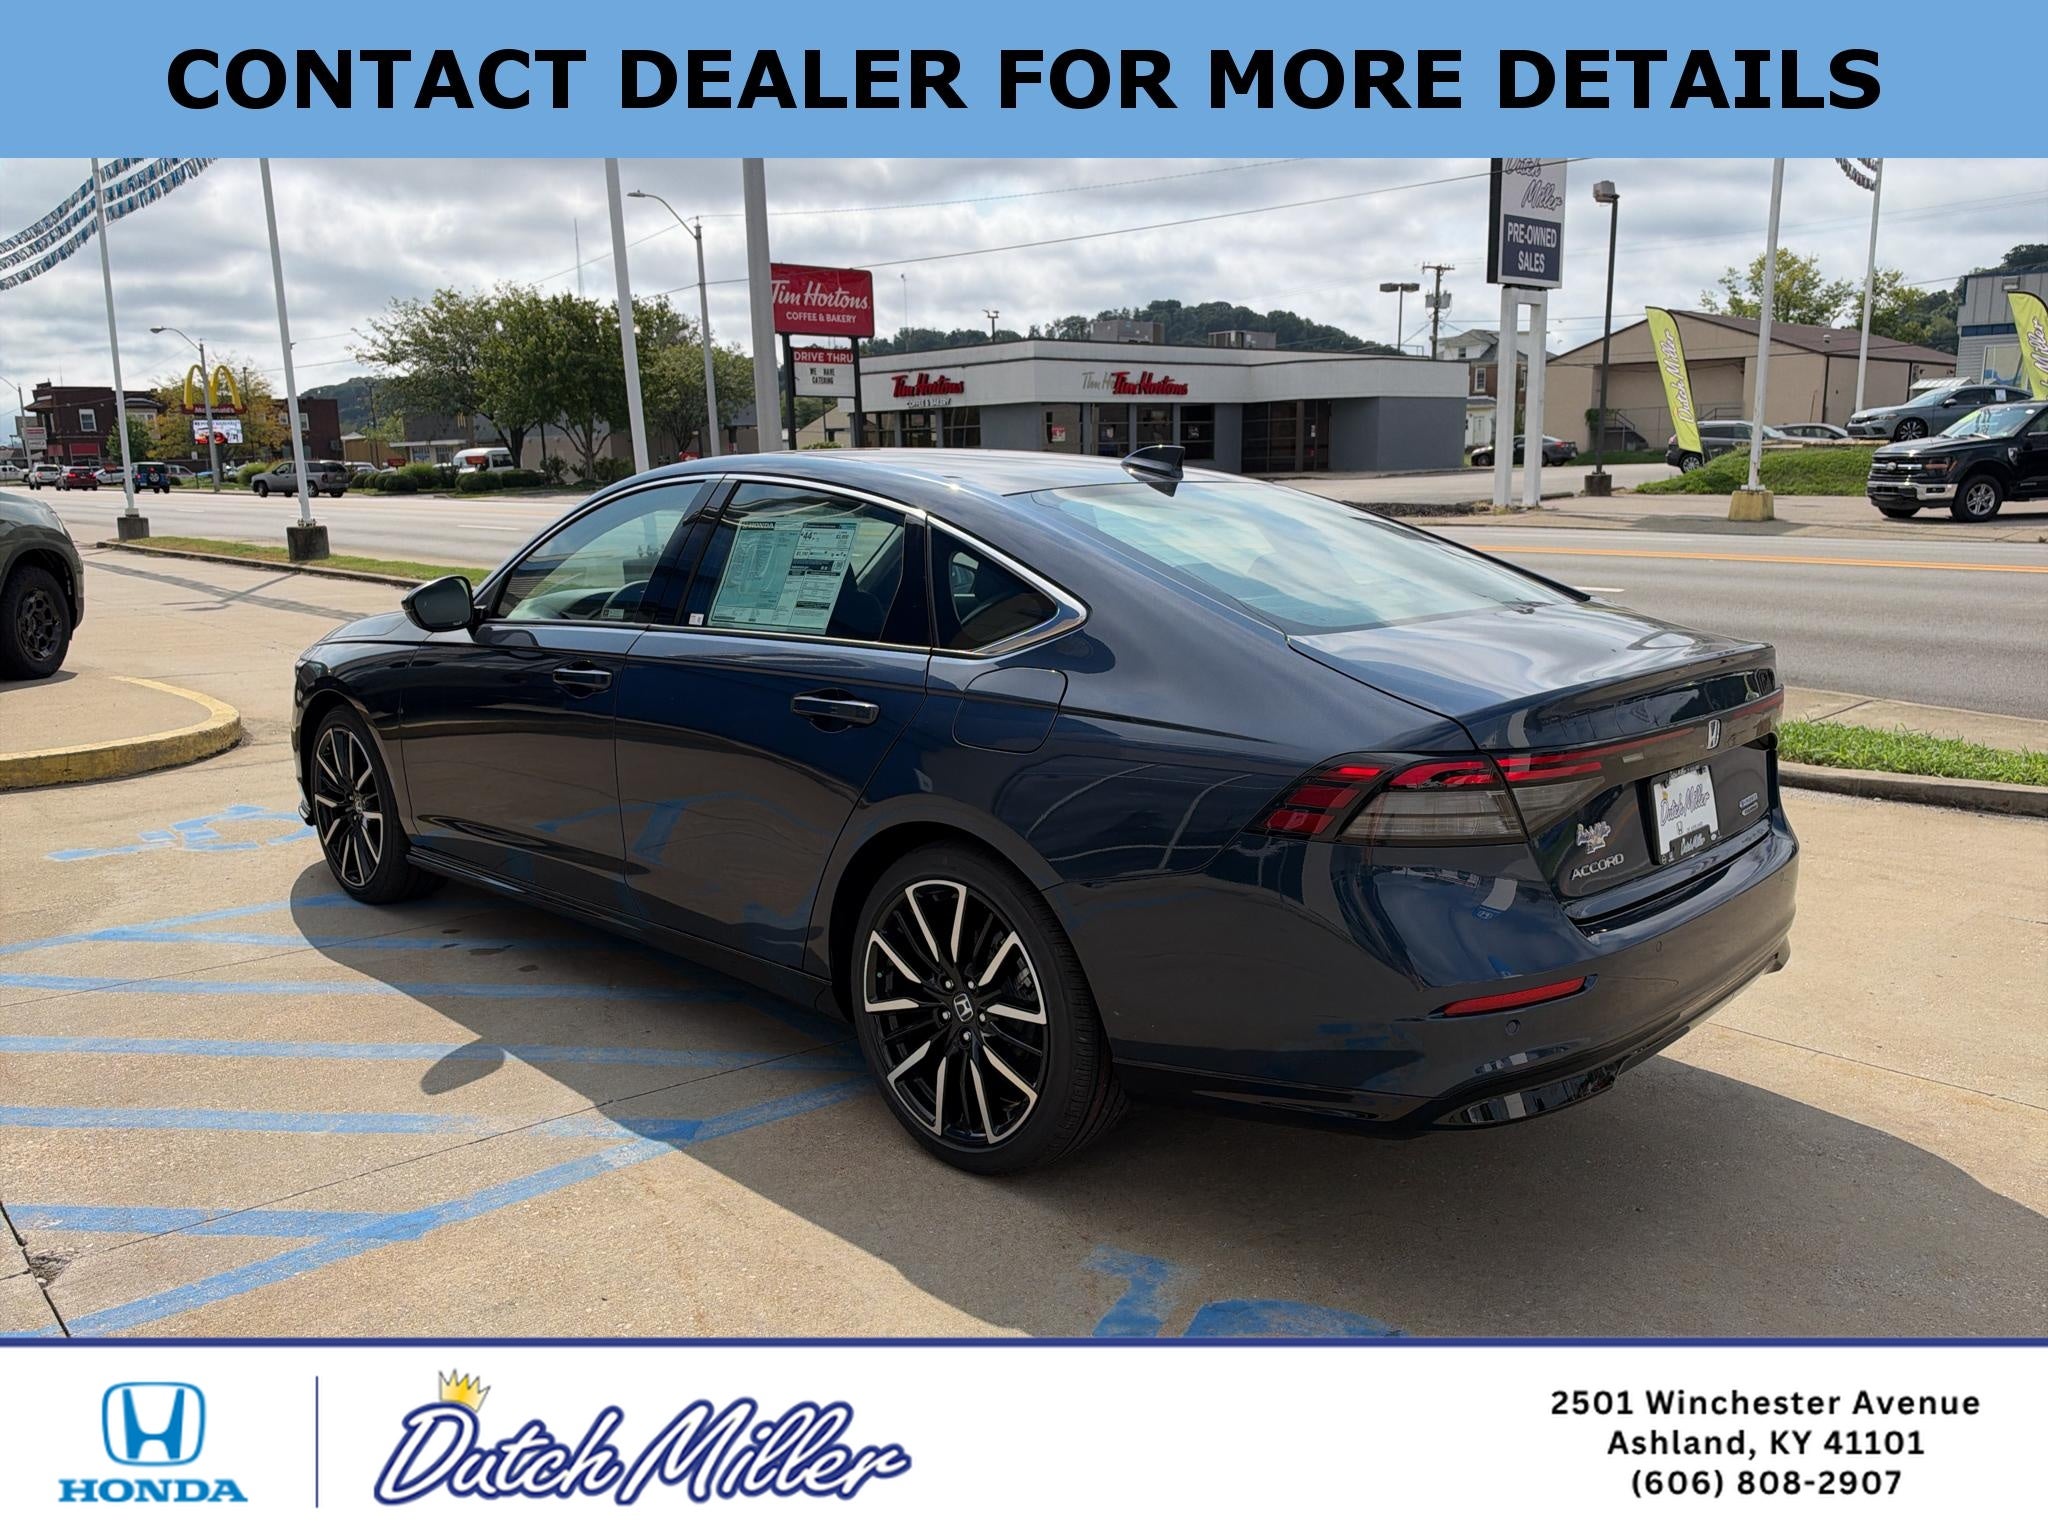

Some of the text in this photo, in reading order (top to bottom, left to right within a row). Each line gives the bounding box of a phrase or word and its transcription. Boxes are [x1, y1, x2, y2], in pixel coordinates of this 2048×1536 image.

[1521, 179, 1562, 211] Miller
[1508, 221, 1557, 248] PRE-OWNED
[1518, 250, 1545, 273] SALES
[771, 280, 868, 310] Tim Hortons
[786, 311, 857, 323] COFFEE & BAKERY
[794, 351, 854, 364] DRIVE THRU
[1111, 371, 1137, 395] Tim
[1137, 370, 1188, 396] Hortons
[1660, 328, 1695, 425] Dutch Miller
[1685, 784, 1710, 813] Miller
[1571, 853, 1625, 881] ACCORD
